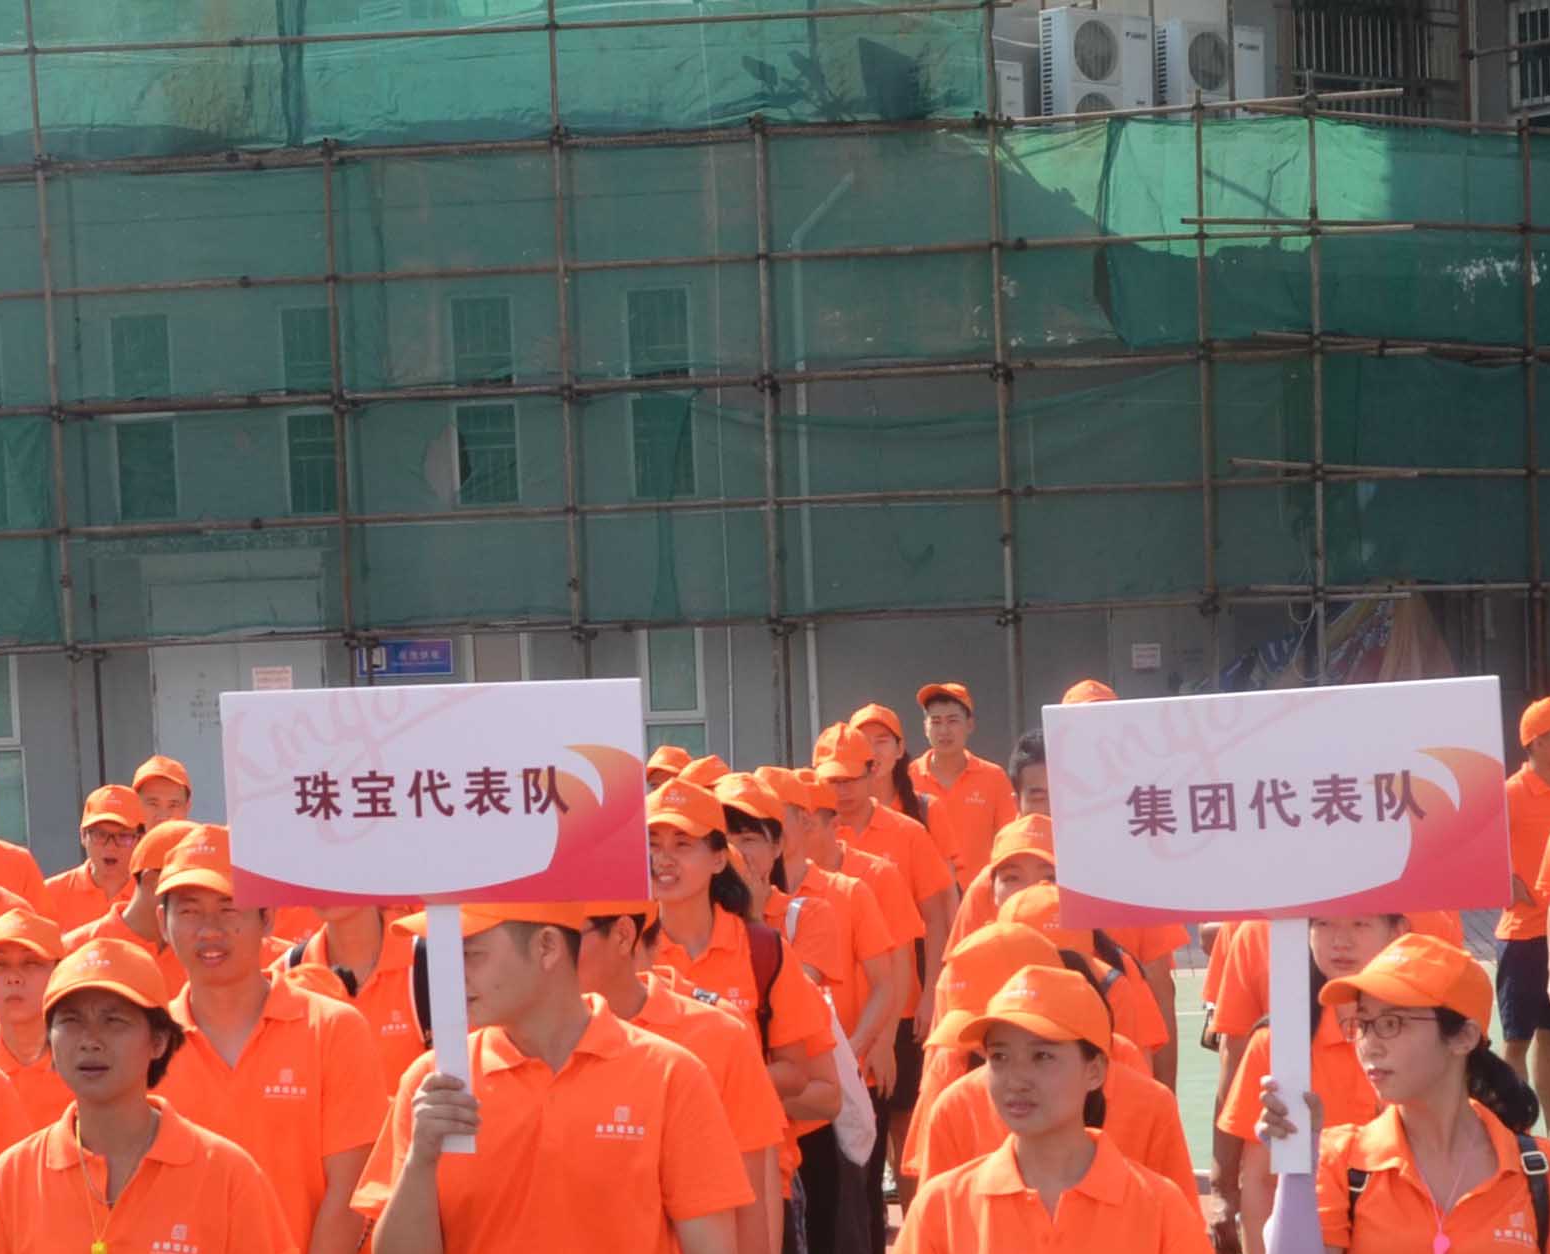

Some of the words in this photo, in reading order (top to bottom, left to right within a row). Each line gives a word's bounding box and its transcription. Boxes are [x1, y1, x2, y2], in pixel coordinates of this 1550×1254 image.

[293, 765, 571, 821] 珠宝代表队
[1125, 769, 1428, 838] 集团代表队
